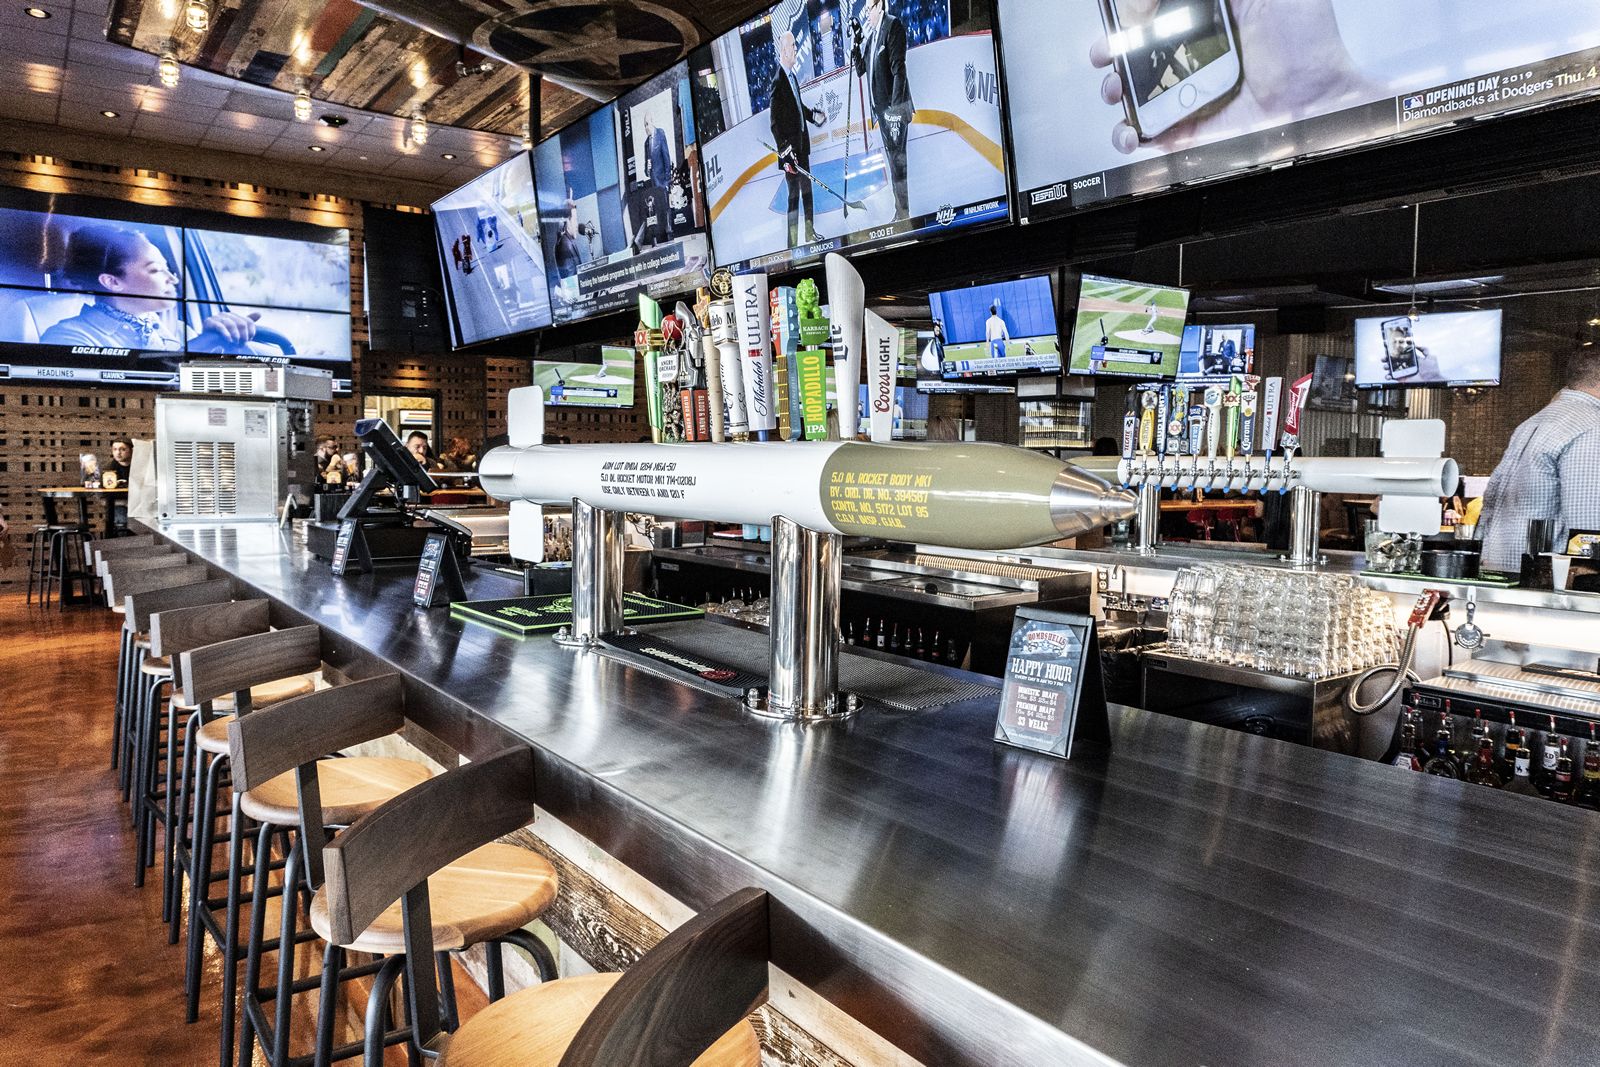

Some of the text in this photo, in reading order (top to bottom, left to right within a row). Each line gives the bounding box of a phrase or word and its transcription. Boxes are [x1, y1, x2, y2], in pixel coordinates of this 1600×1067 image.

[1403, 66, 1597, 122] Diamondbacks at Dodgers Thu. 4
[1426, 82, 1475, 105] OPENING
[1502, 71, 1533, 85] 2019
[1073, 176, 1101, 190] SOCCER
[935, 209, 957, 223] NHL
[869, 226, 894, 240] 10:00 ET
[809, 241, 834, 254] CANUCKS
[634, 264, 642, 272] with
[646, 257, 659, 270] college
[660, 251, 679, 264] basketball
[744, 284, 761, 346] ULTRA
[831, 324, 849, 362] Lite
[72, 346, 131, 357] LOCAL AGENT
[37, 368, 74, 378] HEADLINES
[102, 371, 126, 380] HAWKS
[659, 364, 677, 373] ORCHARD
[753, 361, 768, 417] Michelob
[803, 355, 823, 424] HOPADILLO
[874, 373, 891, 413] Coors
[1267, 381, 1276, 410] ULTRA
[1224, 395, 1238, 403] XX
[699, 416, 707, 436] HONEY
[806, 424, 827, 435] IPA
[1241, 419, 1251, 451] Corona
[617, 474, 635, 483] ROCKET
[637, 475, 653, 484] MOTOR
[831, 472, 932, 487] 5.0 IN. ROCKET BODY MK1
[602, 486, 612, 494] USE
[612, 486, 625, 495] ONLY
[626, 487, 650, 496] BETWEEN
[657, 489, 669, 498] AND
[830, 486, 842, 497] BY.
[844, 487, 861, 498] ORD.
[863, 488, 875, 499] DR.
[878, 488, 891, 500] NO.
[831, 500, 929, 518] CONTR. NO. 5172 LOT 95
[1028, 632, 1066, 645] BOMBSHELLS
[1011, 658, 1072, 682] HAPPY HOUR
[1018, 686, 1058, 700] DOMESTIC DRAFT
[1016, 701, 1056, 715] PREMIUM DRAFT
[1018, 716, 1048, 731] $3 WELLS
